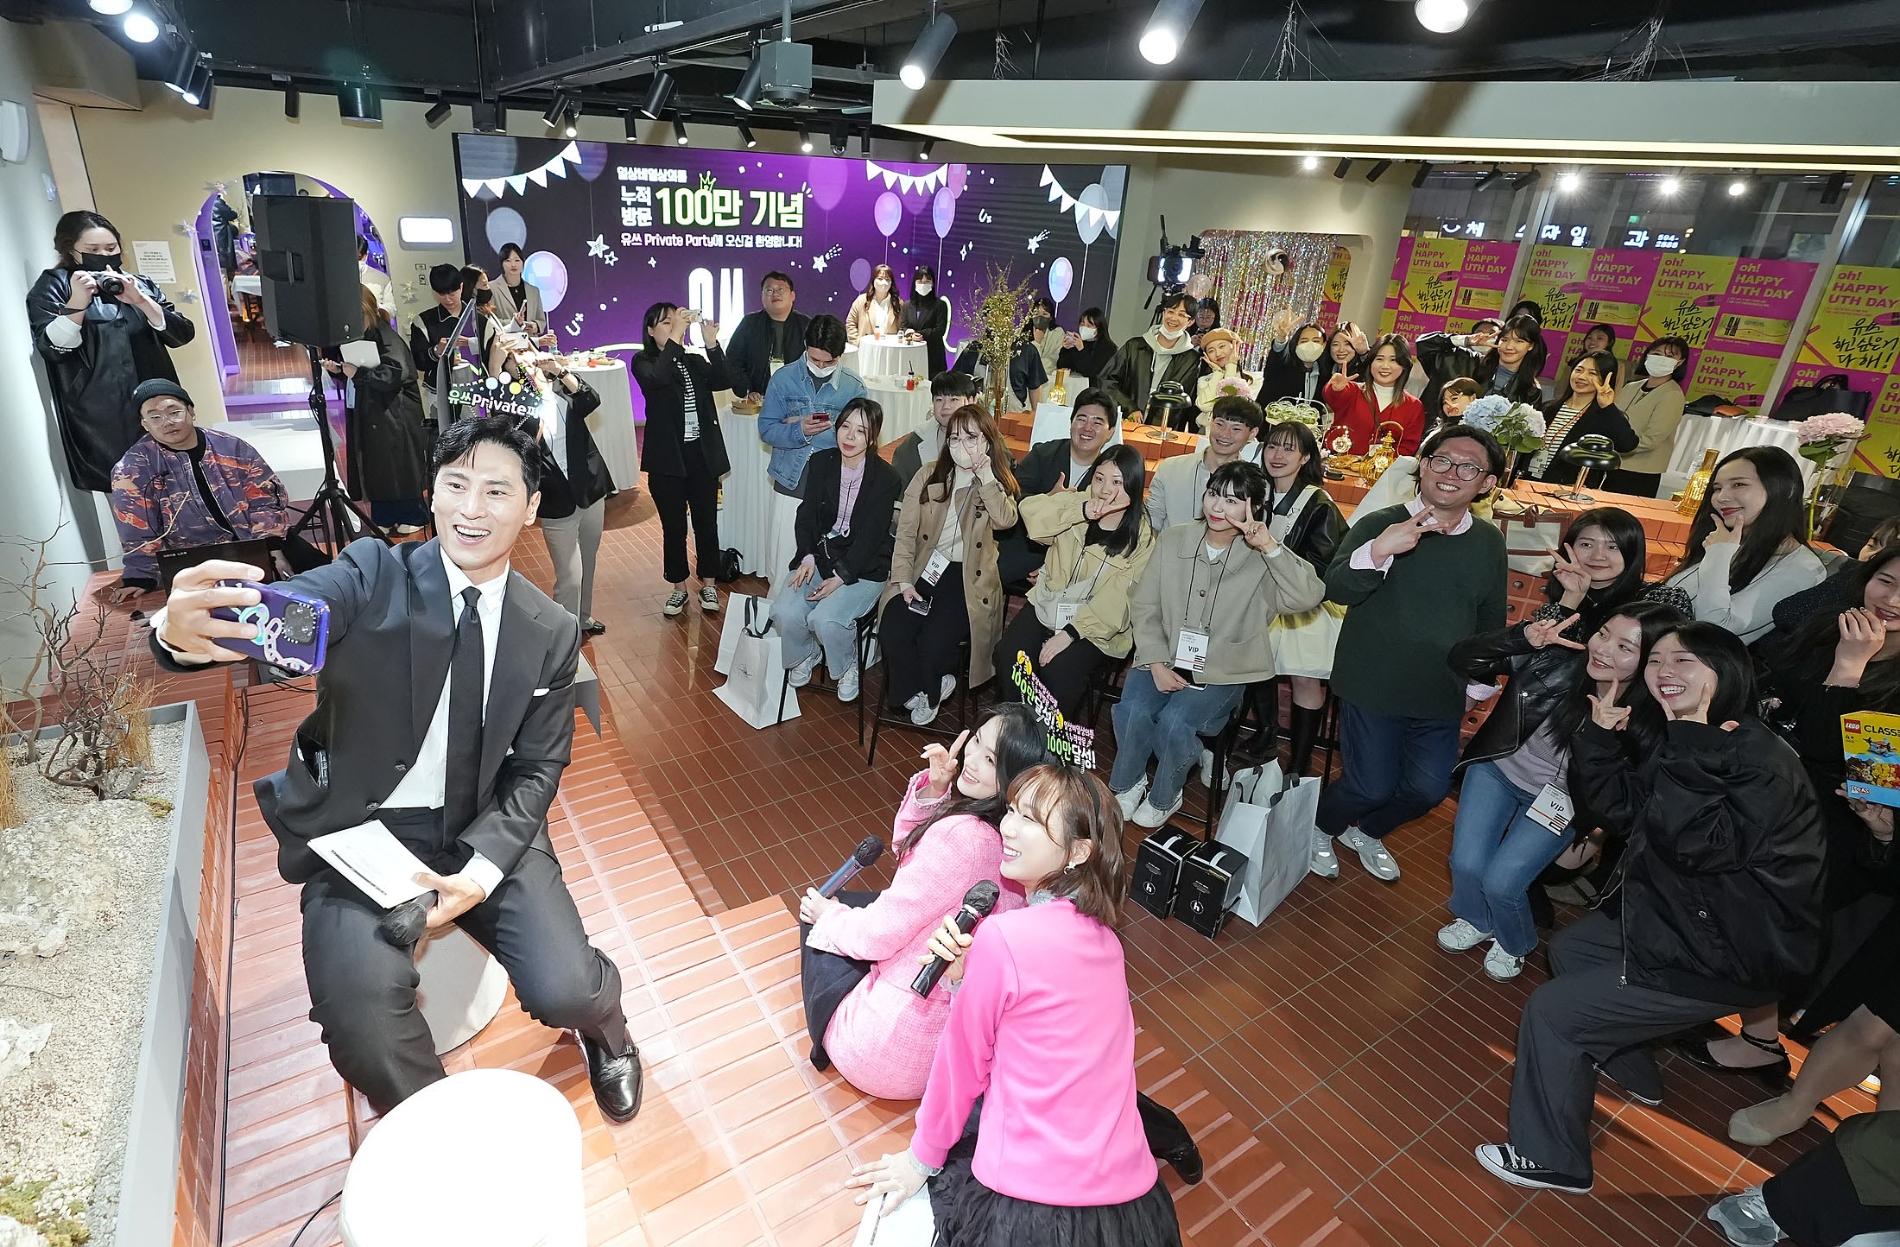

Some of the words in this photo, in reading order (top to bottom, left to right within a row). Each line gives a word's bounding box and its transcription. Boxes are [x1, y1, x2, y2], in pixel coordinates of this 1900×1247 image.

[620, 185, 652, 206] 누적
[655, 187, 744, 228] 100만
[749, 189, 804, 229] 기념
[620, 207, 653, 227] 방문
[620, 232, 643, 247] 유쓰
[644, 233, 683, 247] Private
[685, 233, 724, 249] Party에
[1417, 241, 1430, 249] oh!
[1469, 245, 1485, 253] oh!
[1535, 249, 1553, 257] oh!
[1414, 250, 1445, 260] HAPPY
[1467, 254, 1500, 264] HAPPY
[1596, 253, 1615, 262] oh!
[1412, 259, 1433, 268] UTH
[1433, 261, 1451, 269] DAY
[1532, 258, 1569, 269] HAPPY
[1664, 258, 1685, 267] oh!
[1739, 263, 1762, 273] oh!
[1464, 263, 1486, 272] UTH
[1486, 264, 1507, 274] DAY
[1530, 268, 1553, 278] UTH
[1554, 270, 1577, 280] DAY
[1593, 263, 1635, 274] HAPPY
[1660, 268, 1707, 280] HAPPY
[1590, 273, 1617, 284] UTH
[1617, 275, 1642, 286] DAY
[1734, 273, 1785, 287] HAPPY
[1837, 270, 1864, 281] oh!
[1657, 279, 1687, 290] UTH
[1687, 282, 1714, 292] DAY
[1832, 281, 1890, 295] HAPPY
[1731, 285, 1763, 297] UTH
[1763, 289, 1794, 300] DAY
[1827, 294, 1863, 306] UTH
[1864, 297, 1900, 309] DAY
[1396, 322, 1426, 332] HAPPY
[1704, 355, 1725, 364] oh!
[1700, 365, 1747, 378] HAPPY
[1796, 369, 1821, 379] oh!
[1696, 375, 1725, 387] UTH
[1727, 380, 1756, 391] DAY
[1188, 645, 1200, 653] VIP
[1863, 724, 1900, 737] CLASS
[1046, 733, 1072, 762] 100만
[1071, 743, 1097, 770] 달성!
[1550, 800, 1565, 812] VIP
